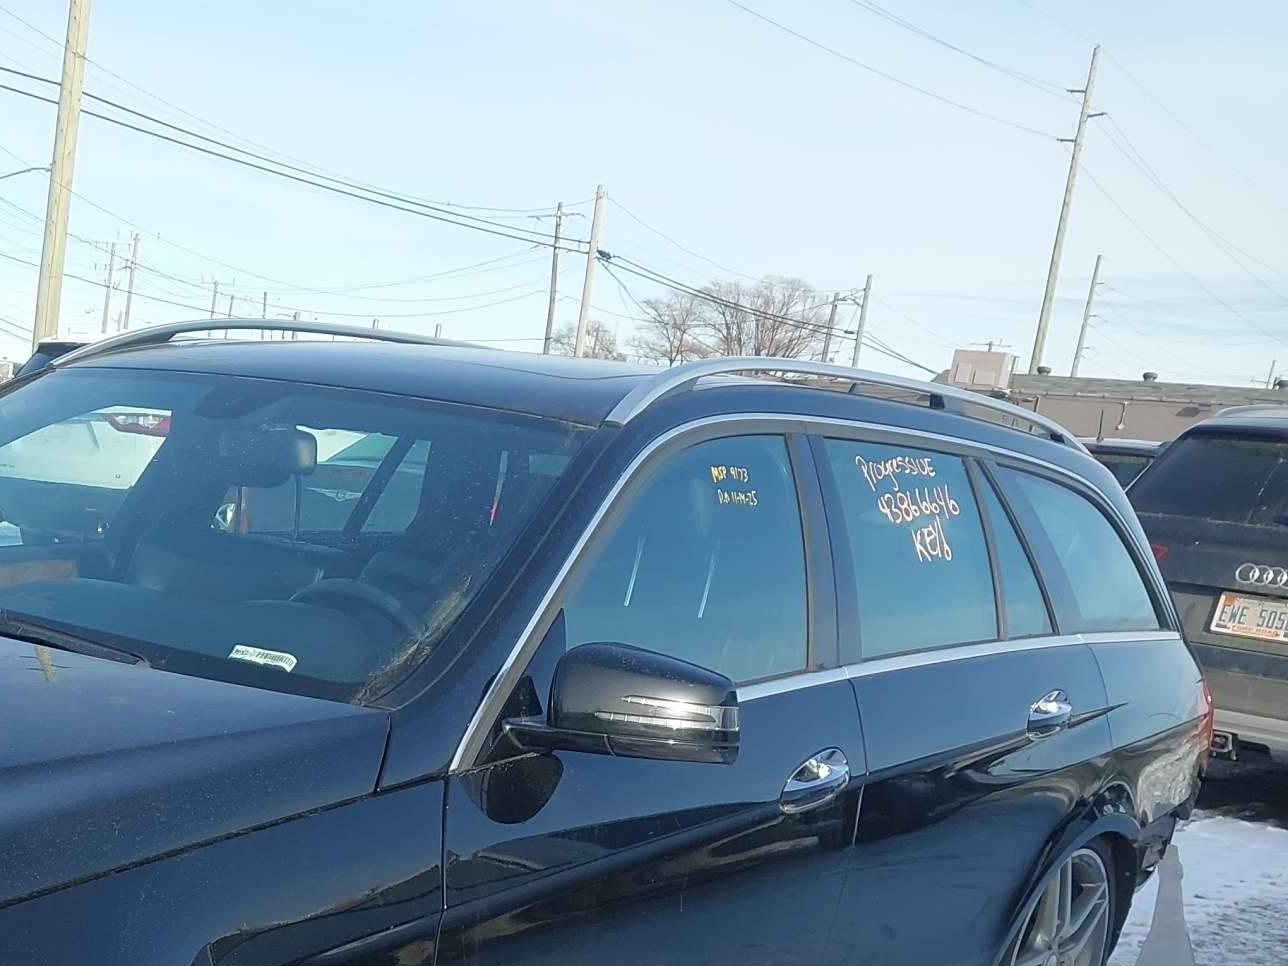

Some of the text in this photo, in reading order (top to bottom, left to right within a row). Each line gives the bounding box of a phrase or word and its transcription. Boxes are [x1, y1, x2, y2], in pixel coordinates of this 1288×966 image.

[729, 466, 749, 482] 9173
[877, 484, 960, 524] 43866646
[1218, 604, 1250, 625] EWE
[1257, 608, 1288, 631] 505
